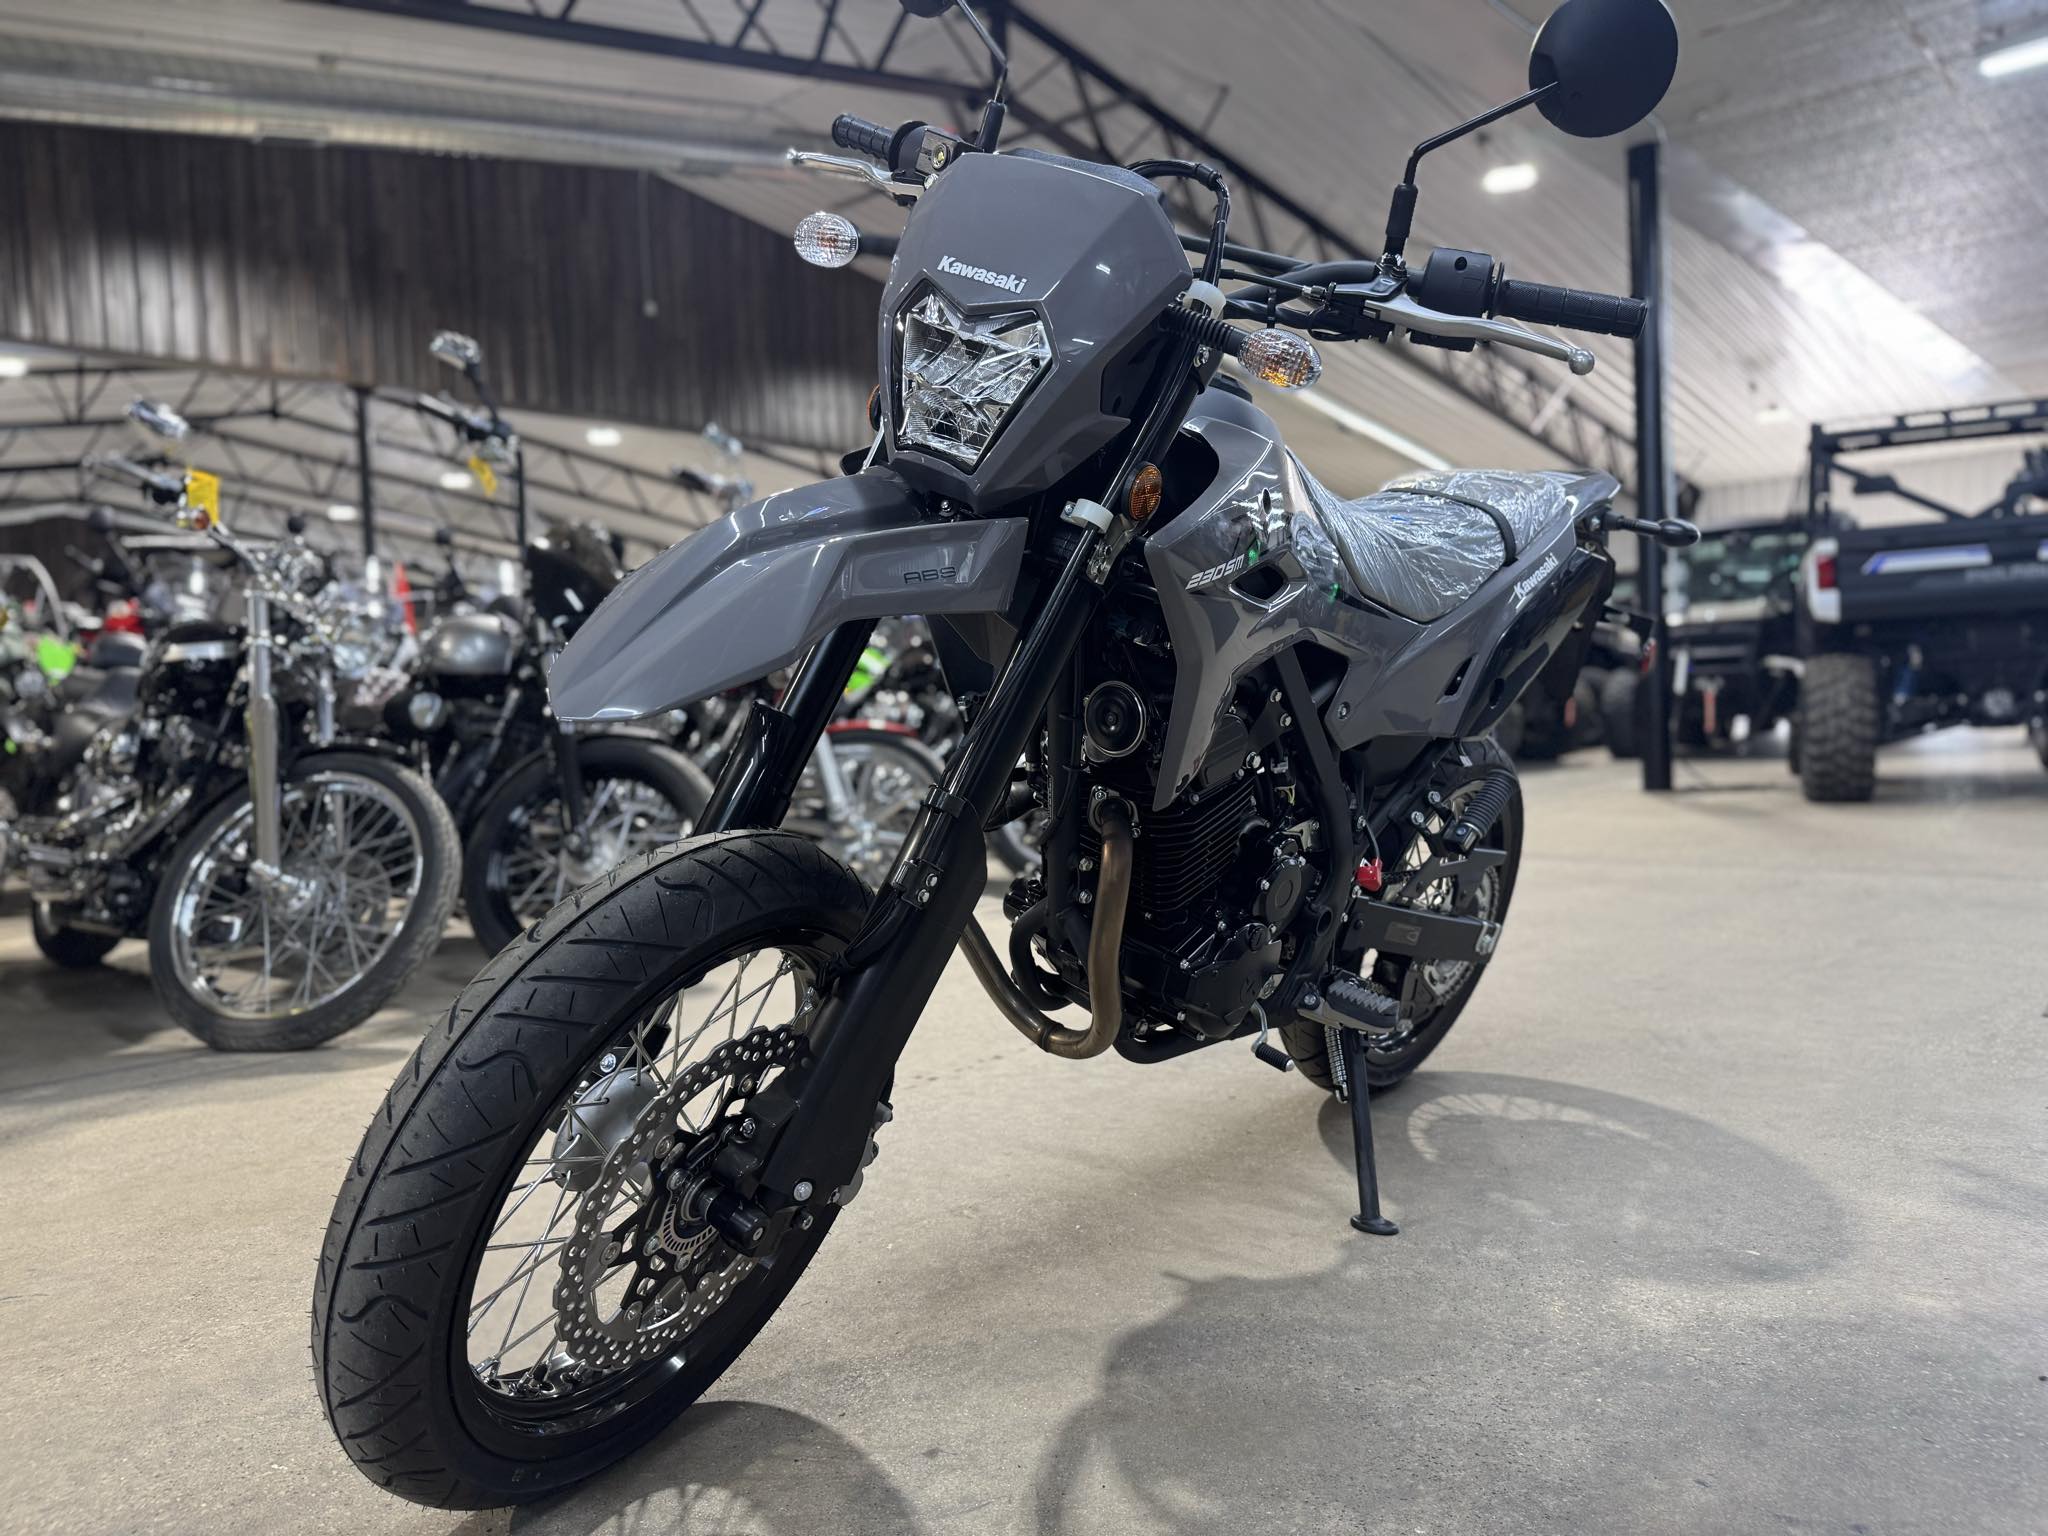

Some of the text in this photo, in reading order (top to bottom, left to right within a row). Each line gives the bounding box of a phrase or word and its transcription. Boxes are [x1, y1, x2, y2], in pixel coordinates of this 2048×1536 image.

[937, 255, 1027, 294] Kawasaki
[903, 566, 957, 584] ABS
[1185, 553, 1245, 590] 230SM
[1513, 552, 1559, 600] Kawasaki
